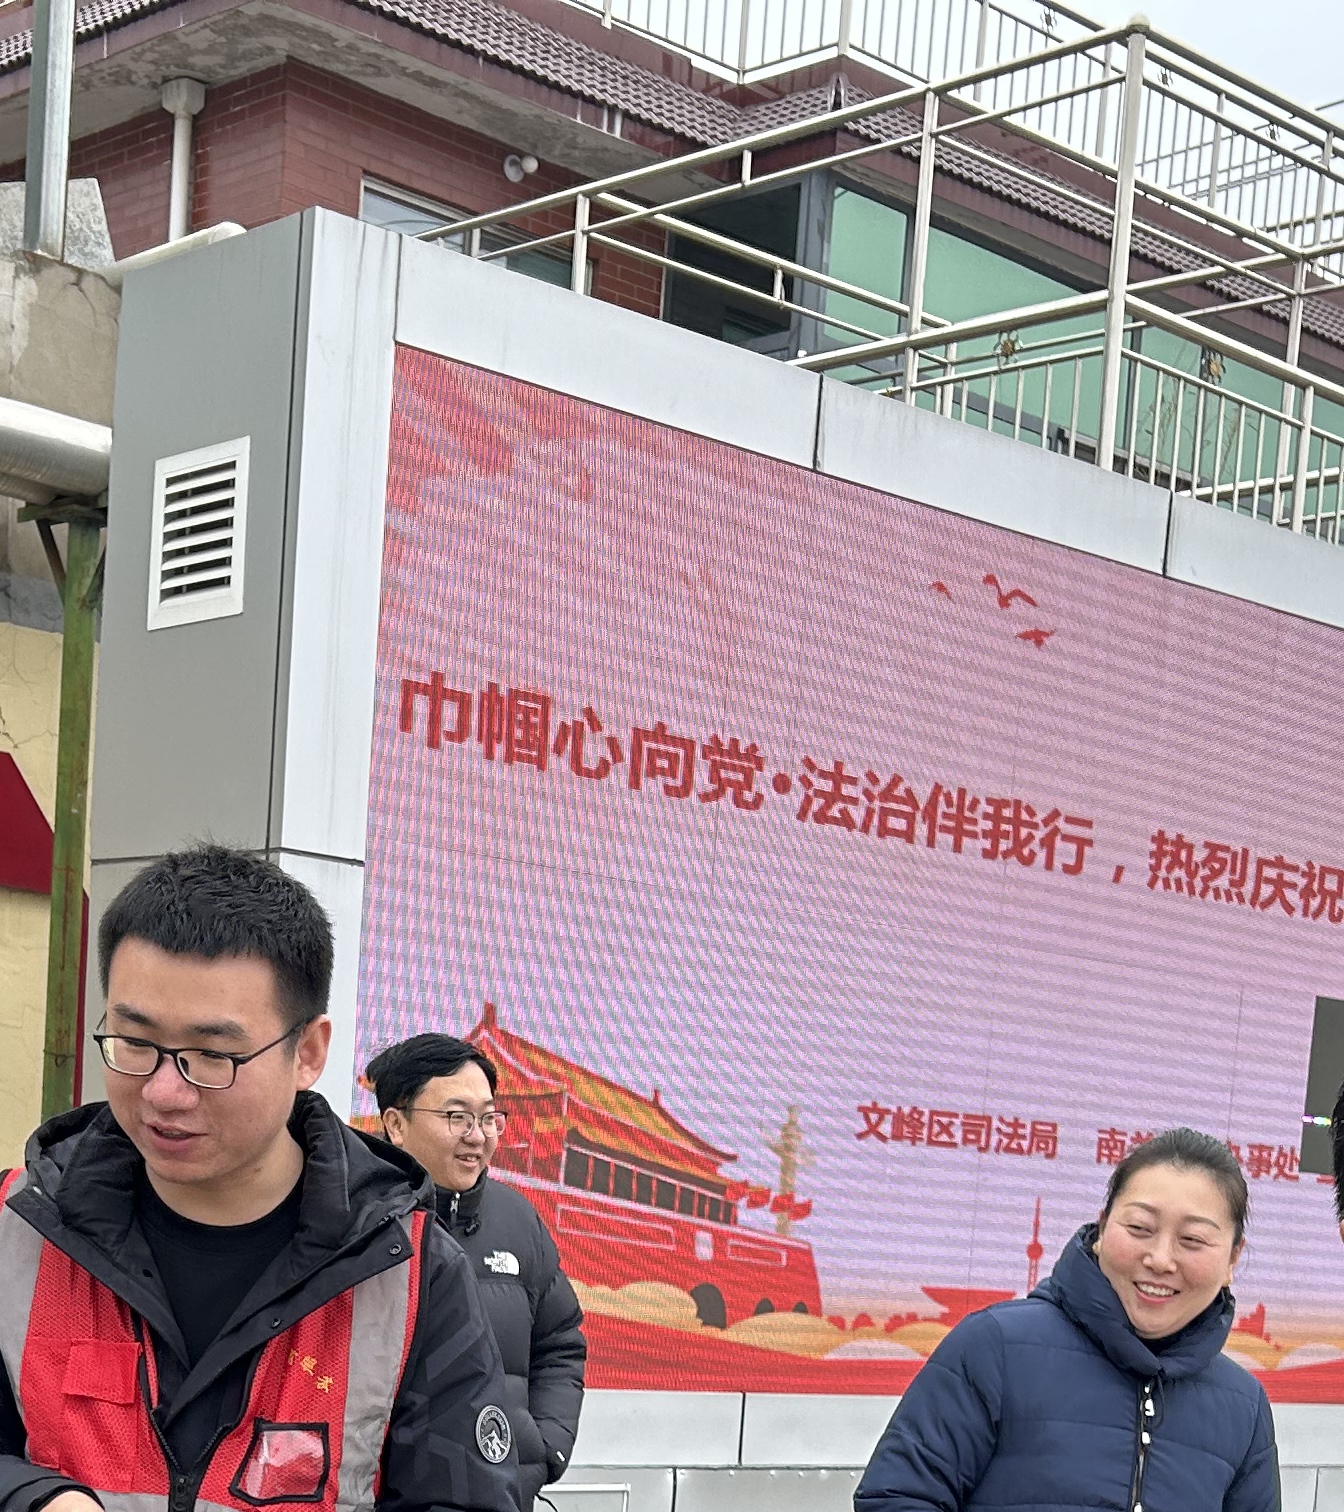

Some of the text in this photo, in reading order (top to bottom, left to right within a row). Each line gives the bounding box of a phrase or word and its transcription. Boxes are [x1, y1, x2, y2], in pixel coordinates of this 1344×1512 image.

[856, 1101, 1058, 1160] 文峰区司法局
